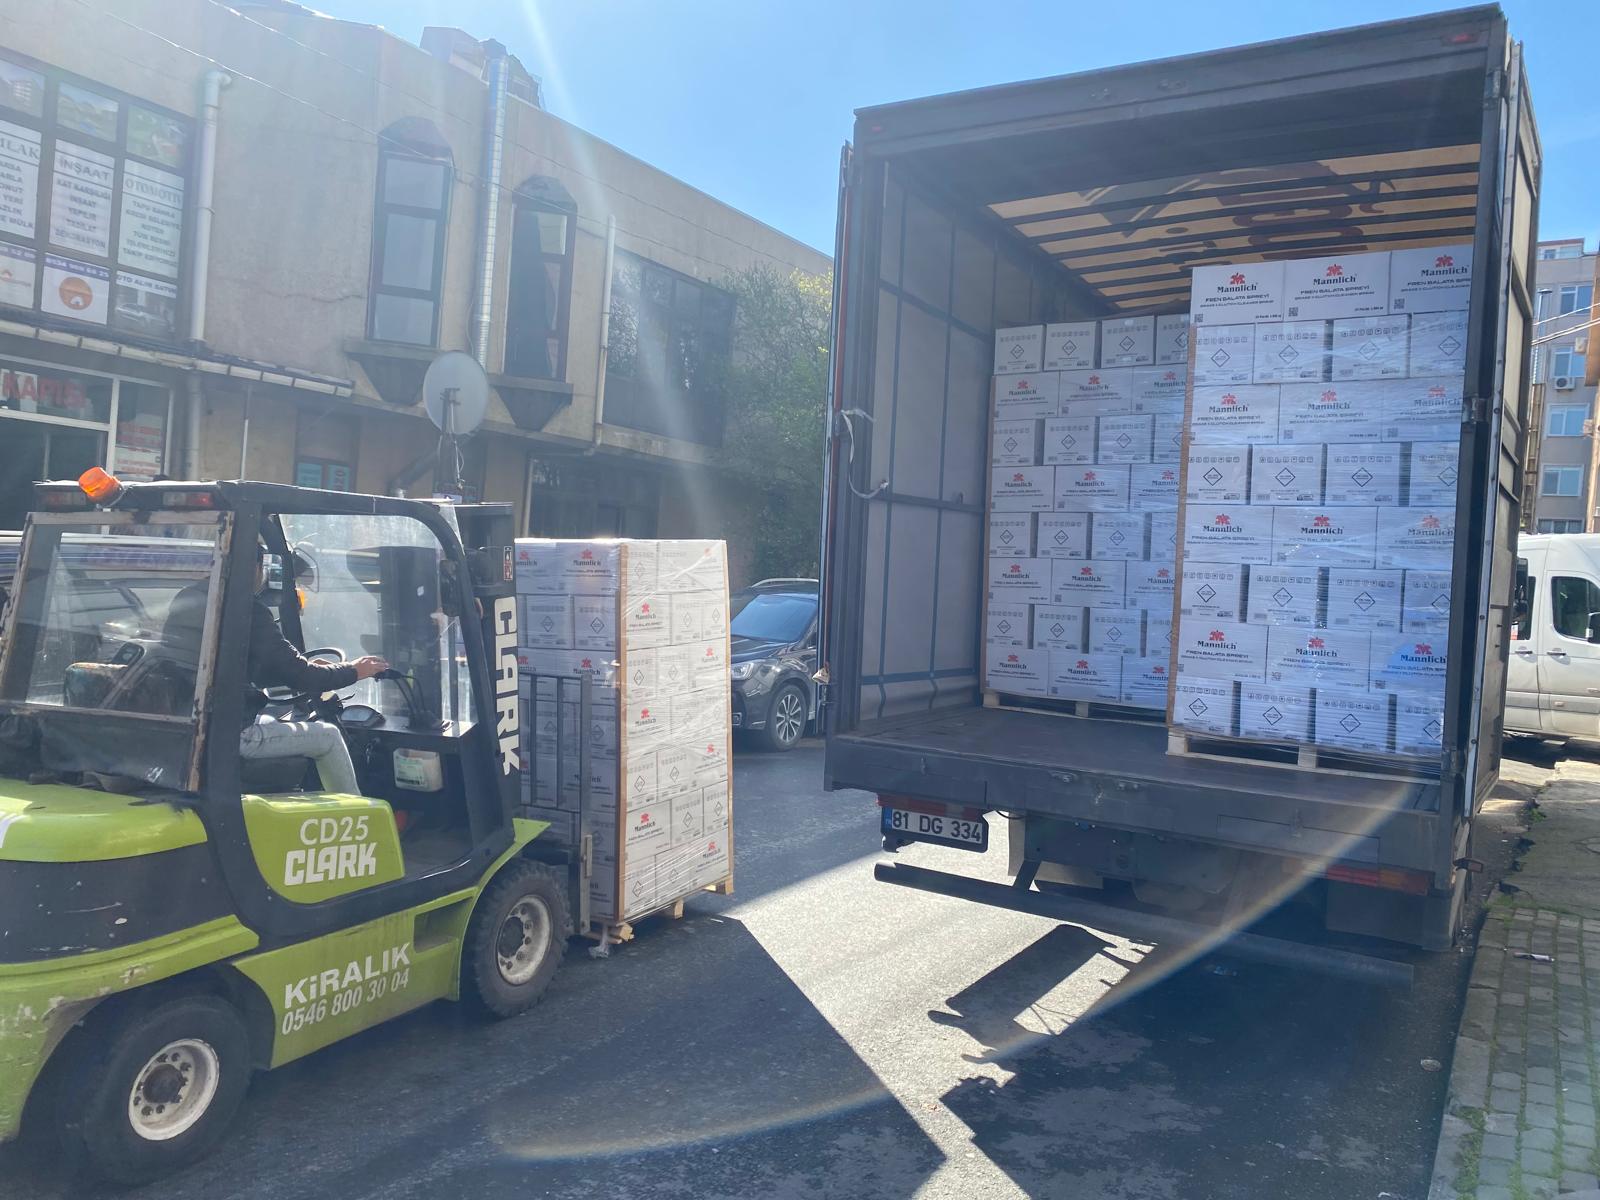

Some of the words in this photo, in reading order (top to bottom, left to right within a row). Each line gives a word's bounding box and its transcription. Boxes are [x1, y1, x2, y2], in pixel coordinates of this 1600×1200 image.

[1421, 266, 1468, 277] Mannlich
[1313, 276, 1356, 285] Mannlich
[1217, 284, 1257, 293] Mannlich
[1308, 401, 1350, 410] Mannlich
[1197, 640, 1236, 650] Mannlich
[1296, 648, 1337, 657] Mannlich
[1400, 654, 1446, 664] Mannlich
[999, 662, 1027, 670] Mannlich
[1067, 668, 1097, 676] Mannlich
[494, 596, 520, 776] CLARK
[300, 815, 369, 845] CD25
[892, 811, 909, 829] 81
[920, 816, 942, 834] DG
[951, 820, 980, 842] 334
[284, 842, 377, 886] CLARK
[282, 999, 326, 1036] 0546
[332, 986, 363, 1016] 800
[367, 976, 386, 1002] 30
[391, 967, 410, 991] 04
